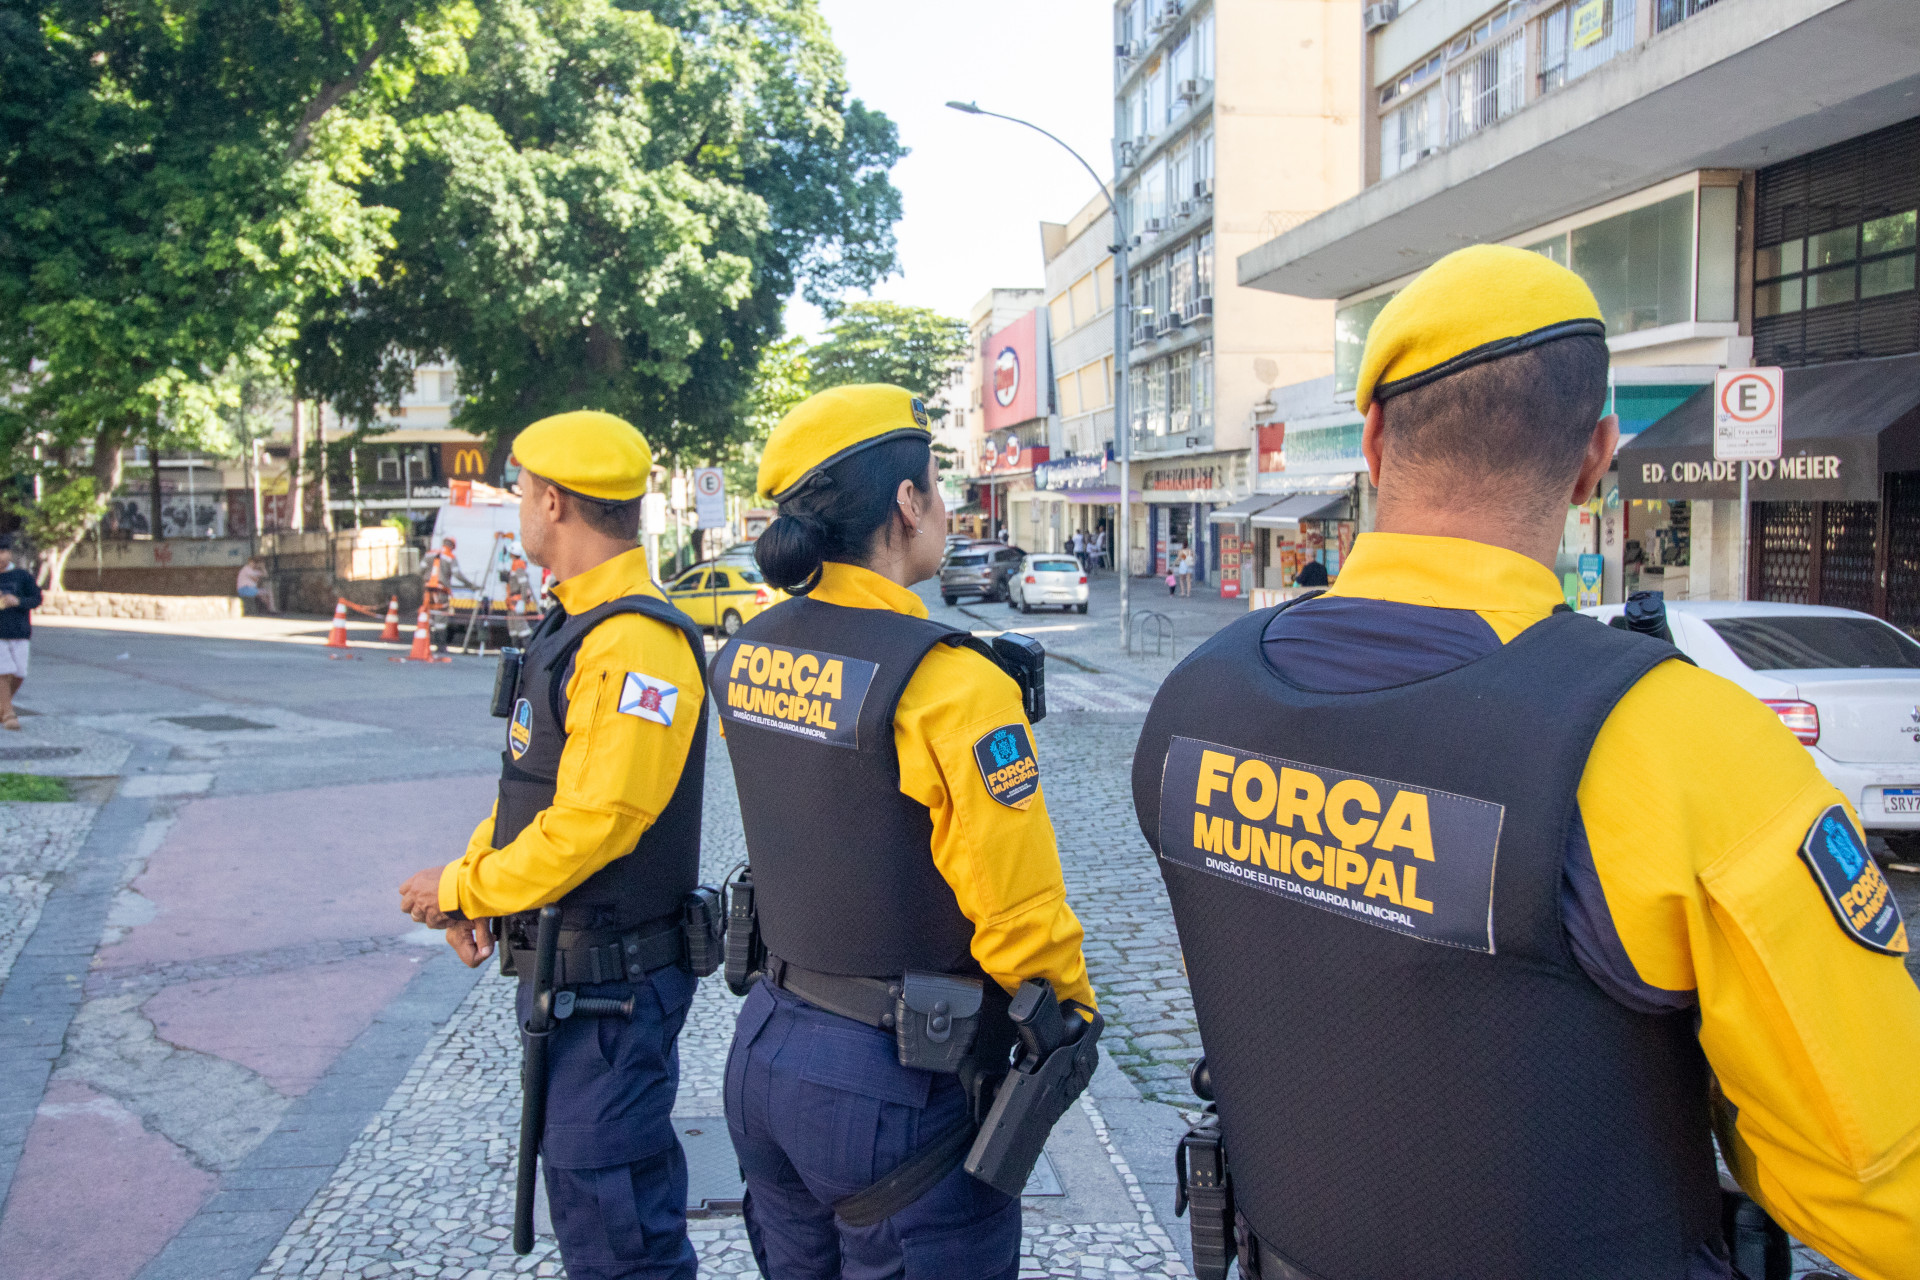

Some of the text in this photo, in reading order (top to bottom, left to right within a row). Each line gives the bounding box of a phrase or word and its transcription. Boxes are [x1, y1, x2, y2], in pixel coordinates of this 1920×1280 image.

[1739, 384, 1757, 411] E
[1671, 460, 1736, 482] CIDADE
[730, 643, 843, 700] FORÇA
[728, 681, 837, 730] MUNICIPAL
[733, 710, 751, 721] DIVISÃO
[757, 716, 771, 726] ELITE
[778, 722, 798, 732] GUARDA
[799, 725, 827, 740] MUNICIPAL
[991, 767, 1038, 795] MUNICIPAL
[1195, 749, 1435, 862] FORÇA
[1193, 811, 1434, 914] MUNICIPAL
[1206, 857, 1415, 928] DIVISÃO DE ELITE DA GUARDA MUNICIPAL
